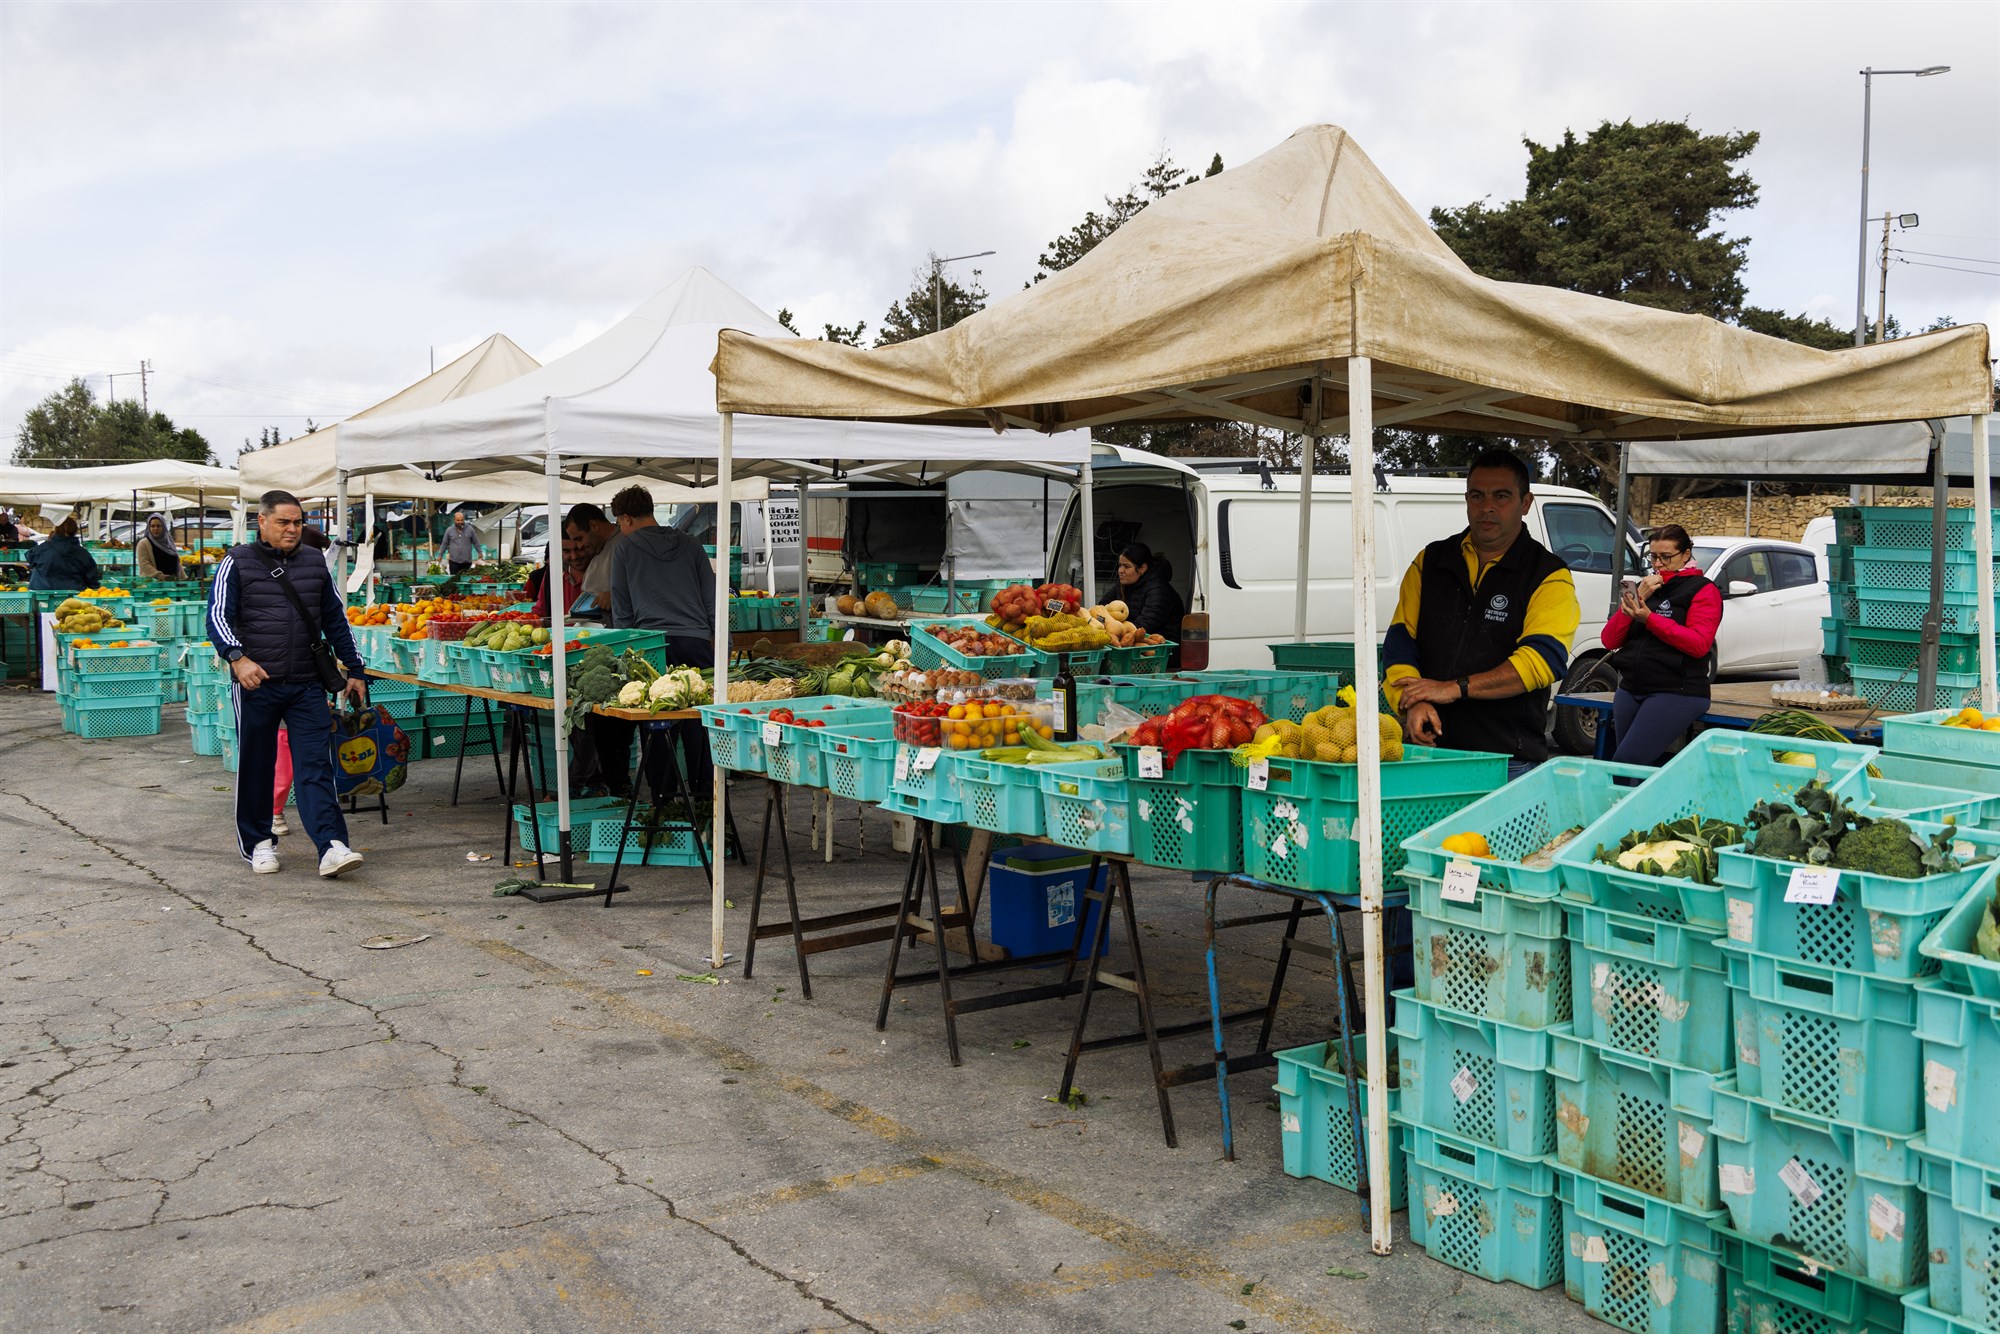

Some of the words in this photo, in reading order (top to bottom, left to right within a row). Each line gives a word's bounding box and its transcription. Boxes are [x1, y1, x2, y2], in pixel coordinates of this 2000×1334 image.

[1485, 609, 1508, 617] Farmers
[1485, 614, 1506, 622] Market
[341, 748, 375, 762] LIDL
